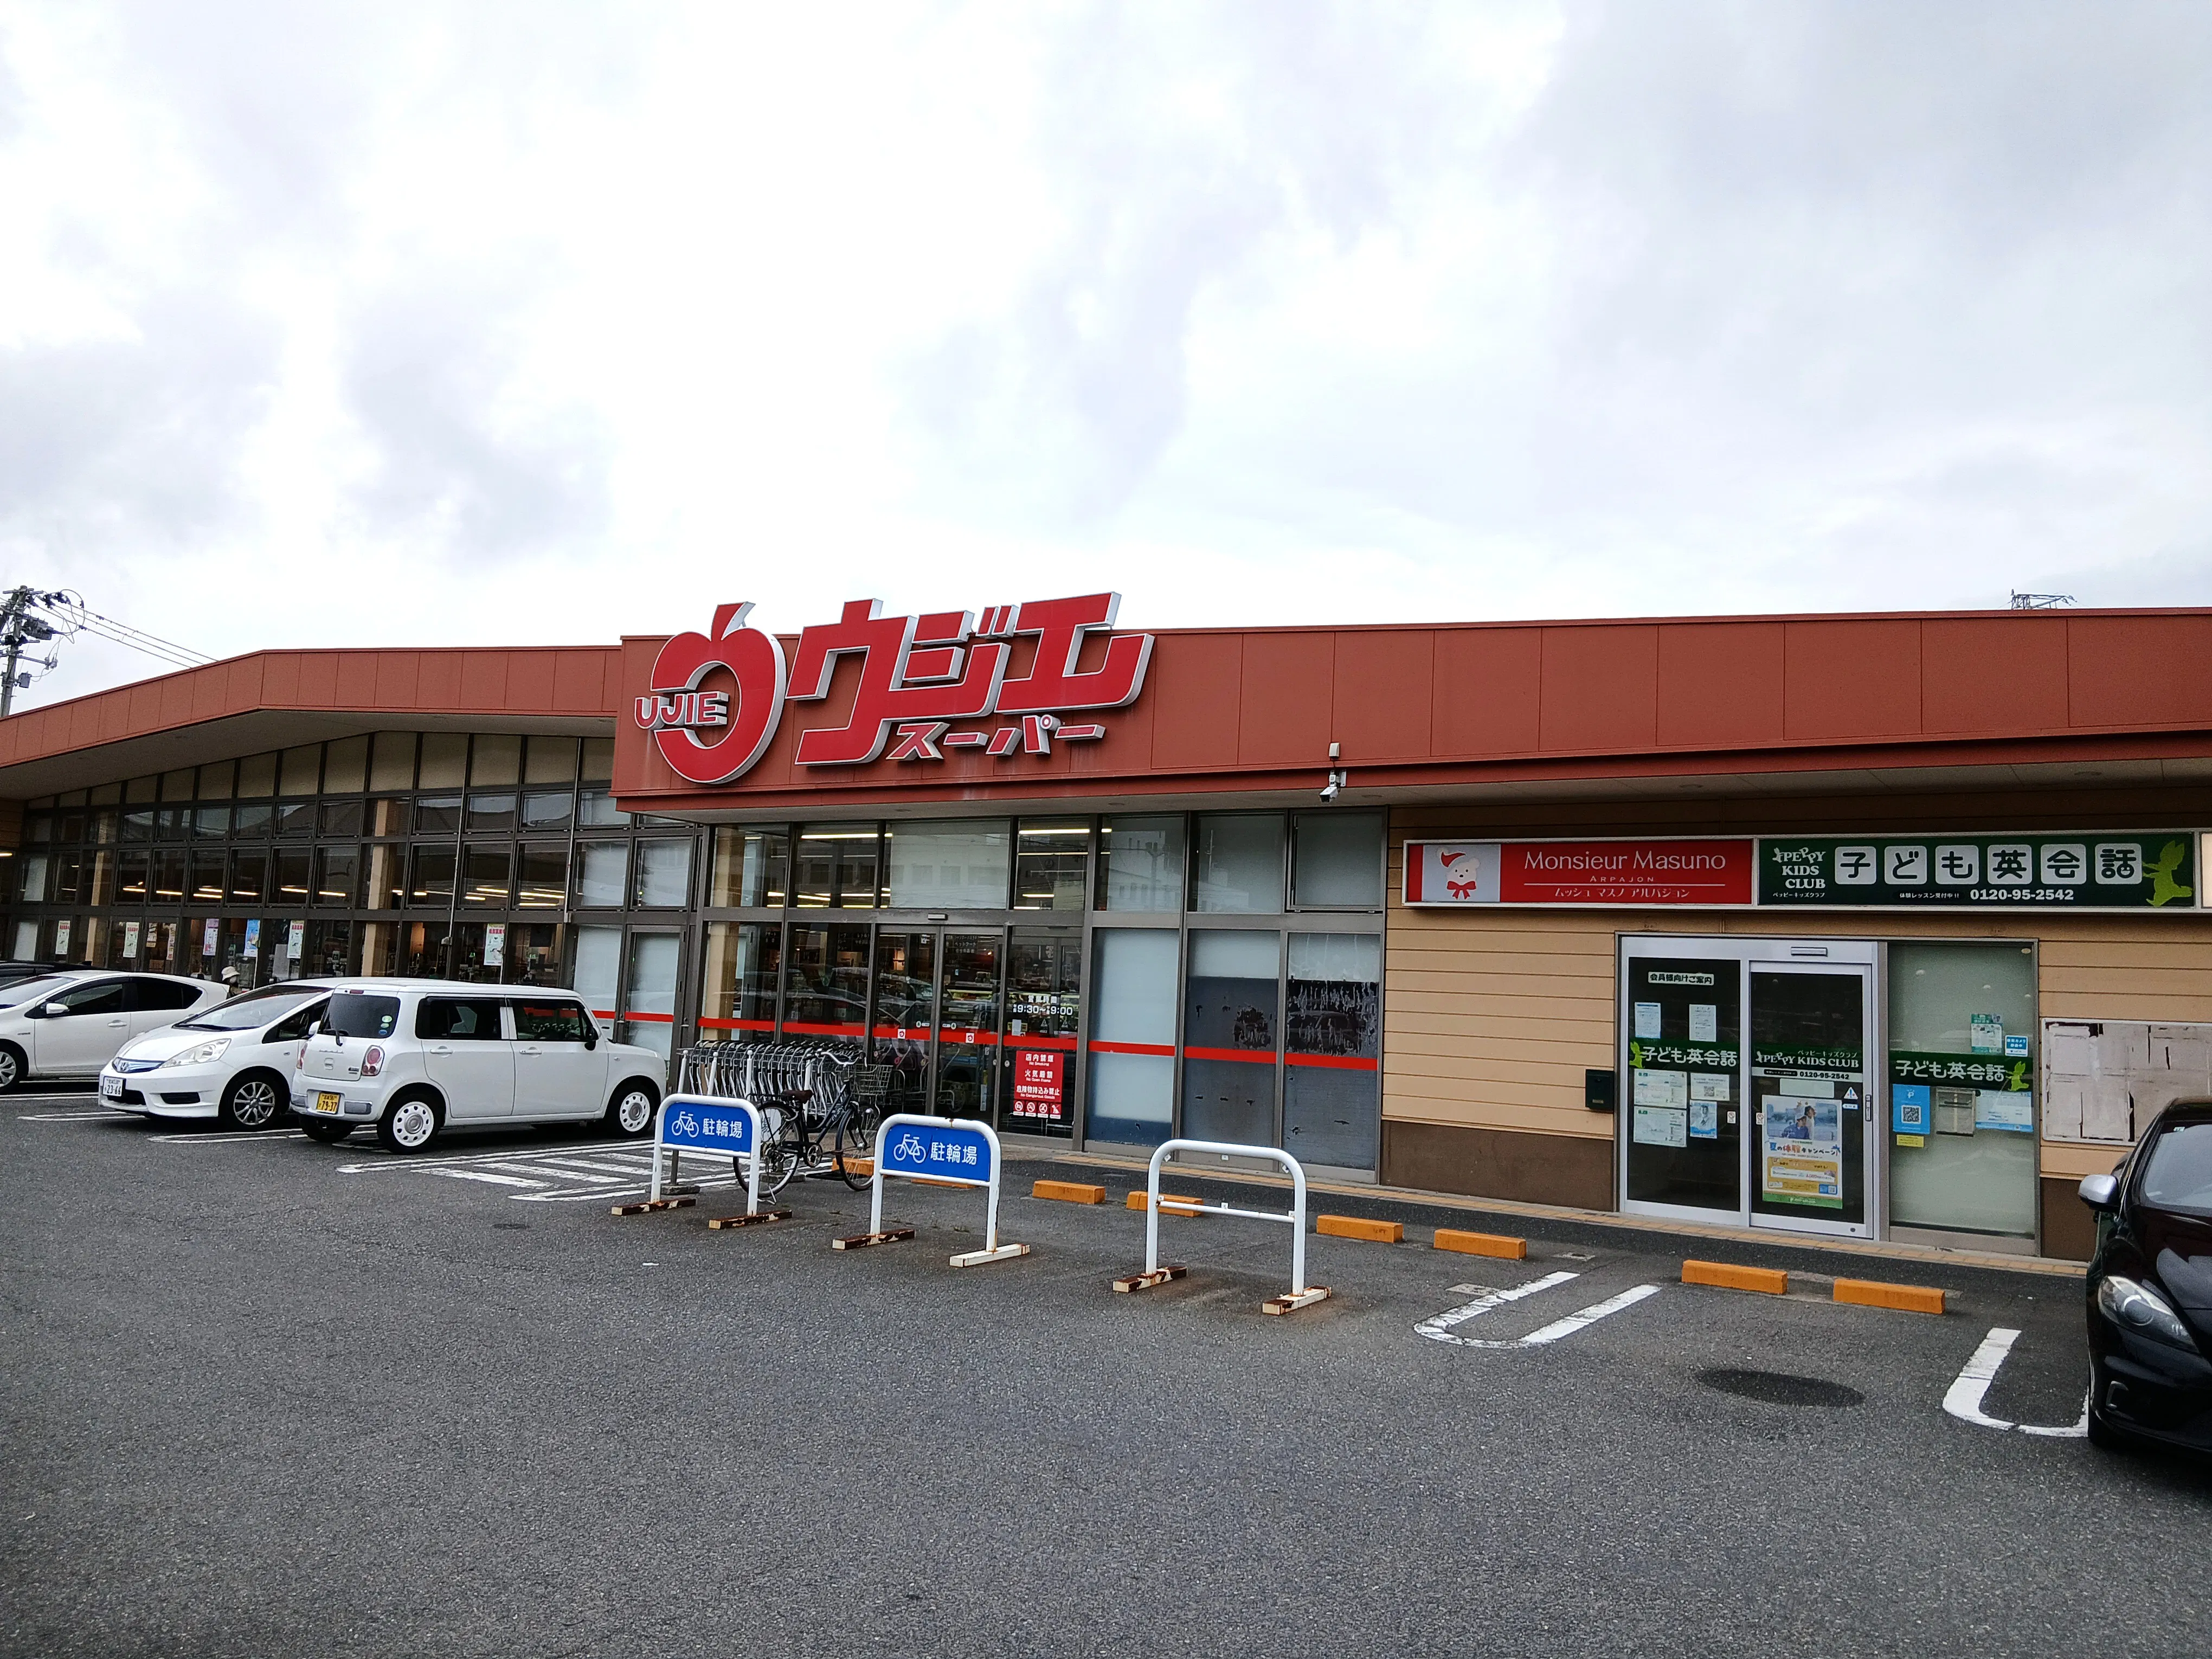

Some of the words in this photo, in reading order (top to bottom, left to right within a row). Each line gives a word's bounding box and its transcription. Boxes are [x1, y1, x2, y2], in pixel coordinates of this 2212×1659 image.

[786, 591, 1155, 766] ウジエ
[634, 691, 729, 730] UJIE
[885, 714, 1106, 760] スーパー
[1524, 851, 1628, 870] Monsieur
[1633, 850, 1725, 870] Masuno
[1780, 847, 1826, 864] PEPPY
[1840, 848, 2137, 879] 子ども英会話
[1782, 865, 1819, 876] KIDS
[1597, 888, 1624, 898] マスノ
[1785, 878, 1826, 889] CLUB
[1970, 889, 2074, 900] 0120-95-2542
[1643, 1046, 1738, 1067] 子ども英会話
[1763, 1052, 1796, 1065] PEPPY
[1797, 1057, 1826, 1066] KIDS
[1828, 1058, 1859, 1068] CLUB
[1799, 1071, 1850, 1079] 0120-95-2542
[1895, 1060, 2006, 1082] 子ども英会話
[702, 1118, 743, 1139] 駐輪場
[930, 1141, 978, 1166] 駐輪場
